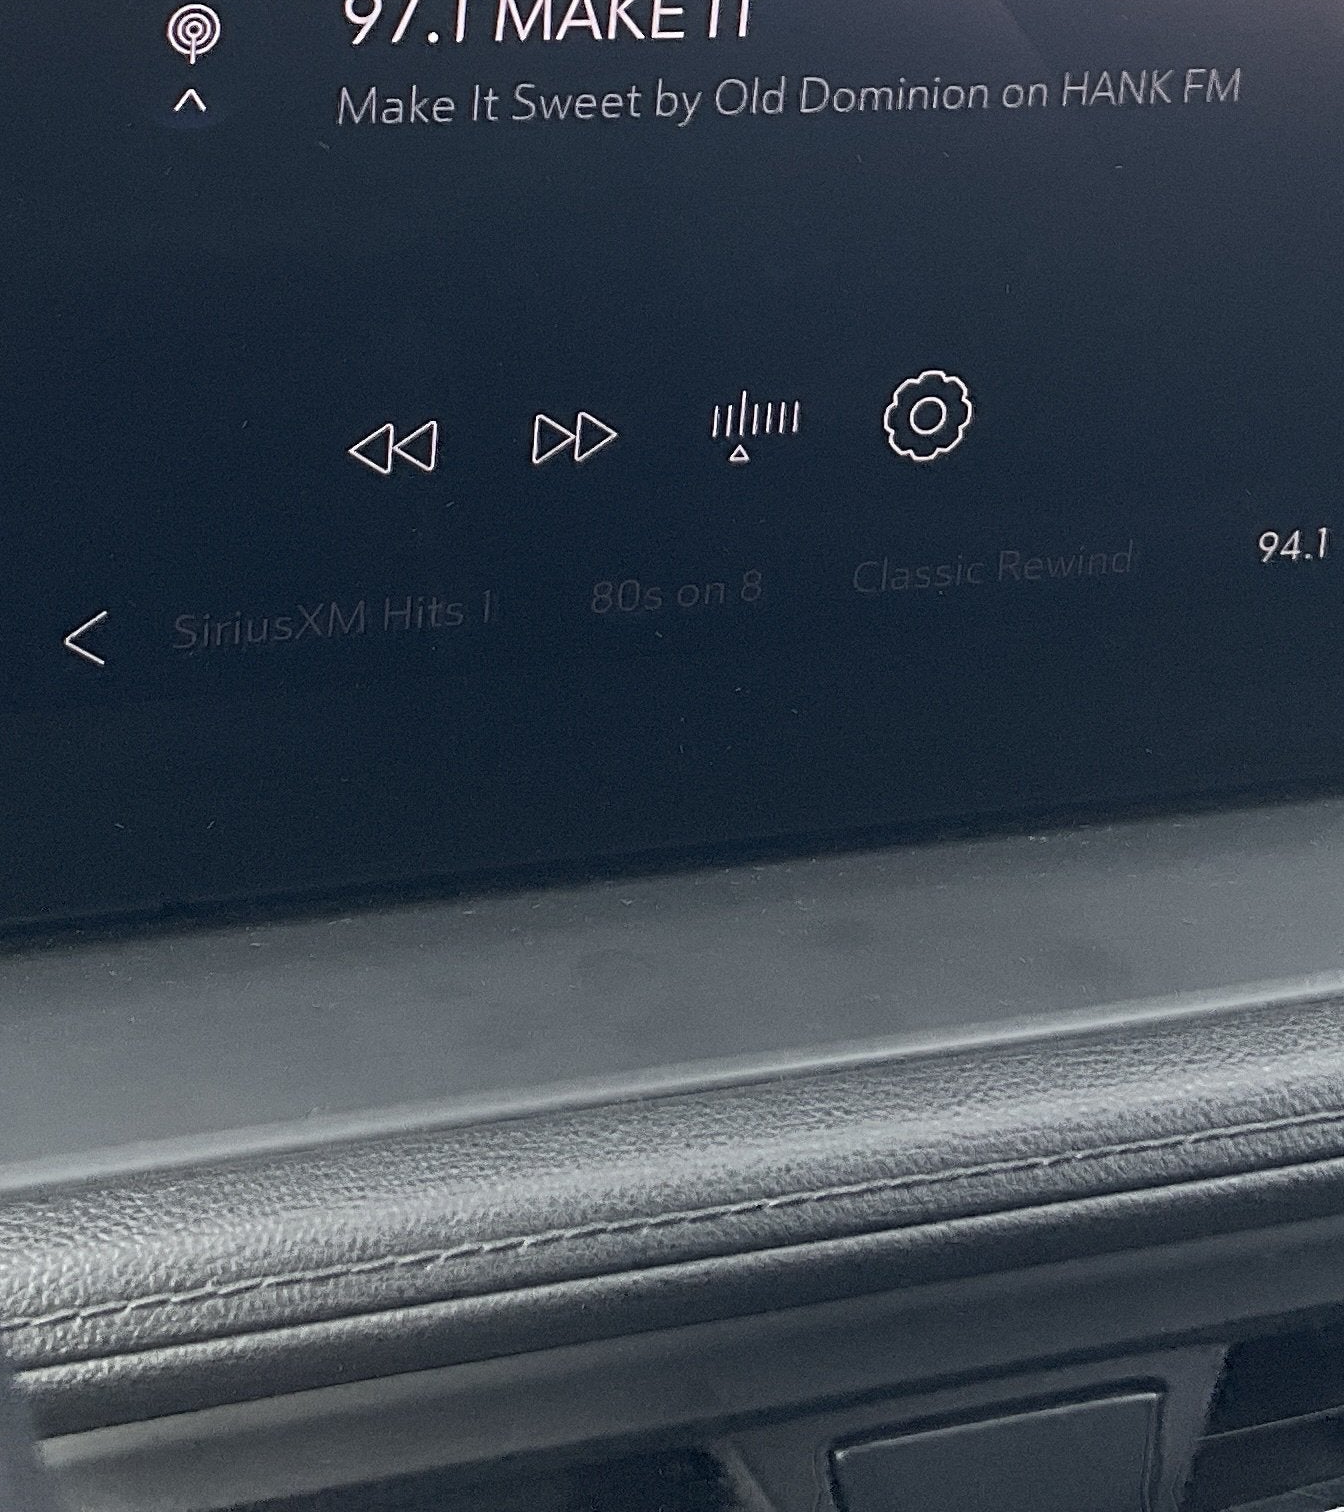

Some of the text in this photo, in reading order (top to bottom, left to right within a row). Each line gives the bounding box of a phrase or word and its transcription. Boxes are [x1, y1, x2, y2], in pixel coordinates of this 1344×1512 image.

[337, 66, 1242, 128] Make It Sweet by Old Dominion on HANK FM
[851, 538, 1135, 595] Classic Rewind
[1258, 526, 1329, 564] 94.1
[589, 569, 764, 616] 80s on 8
[171, 598, 367, 651] SiriusXM
[382, 592, 466, 631] Hits
